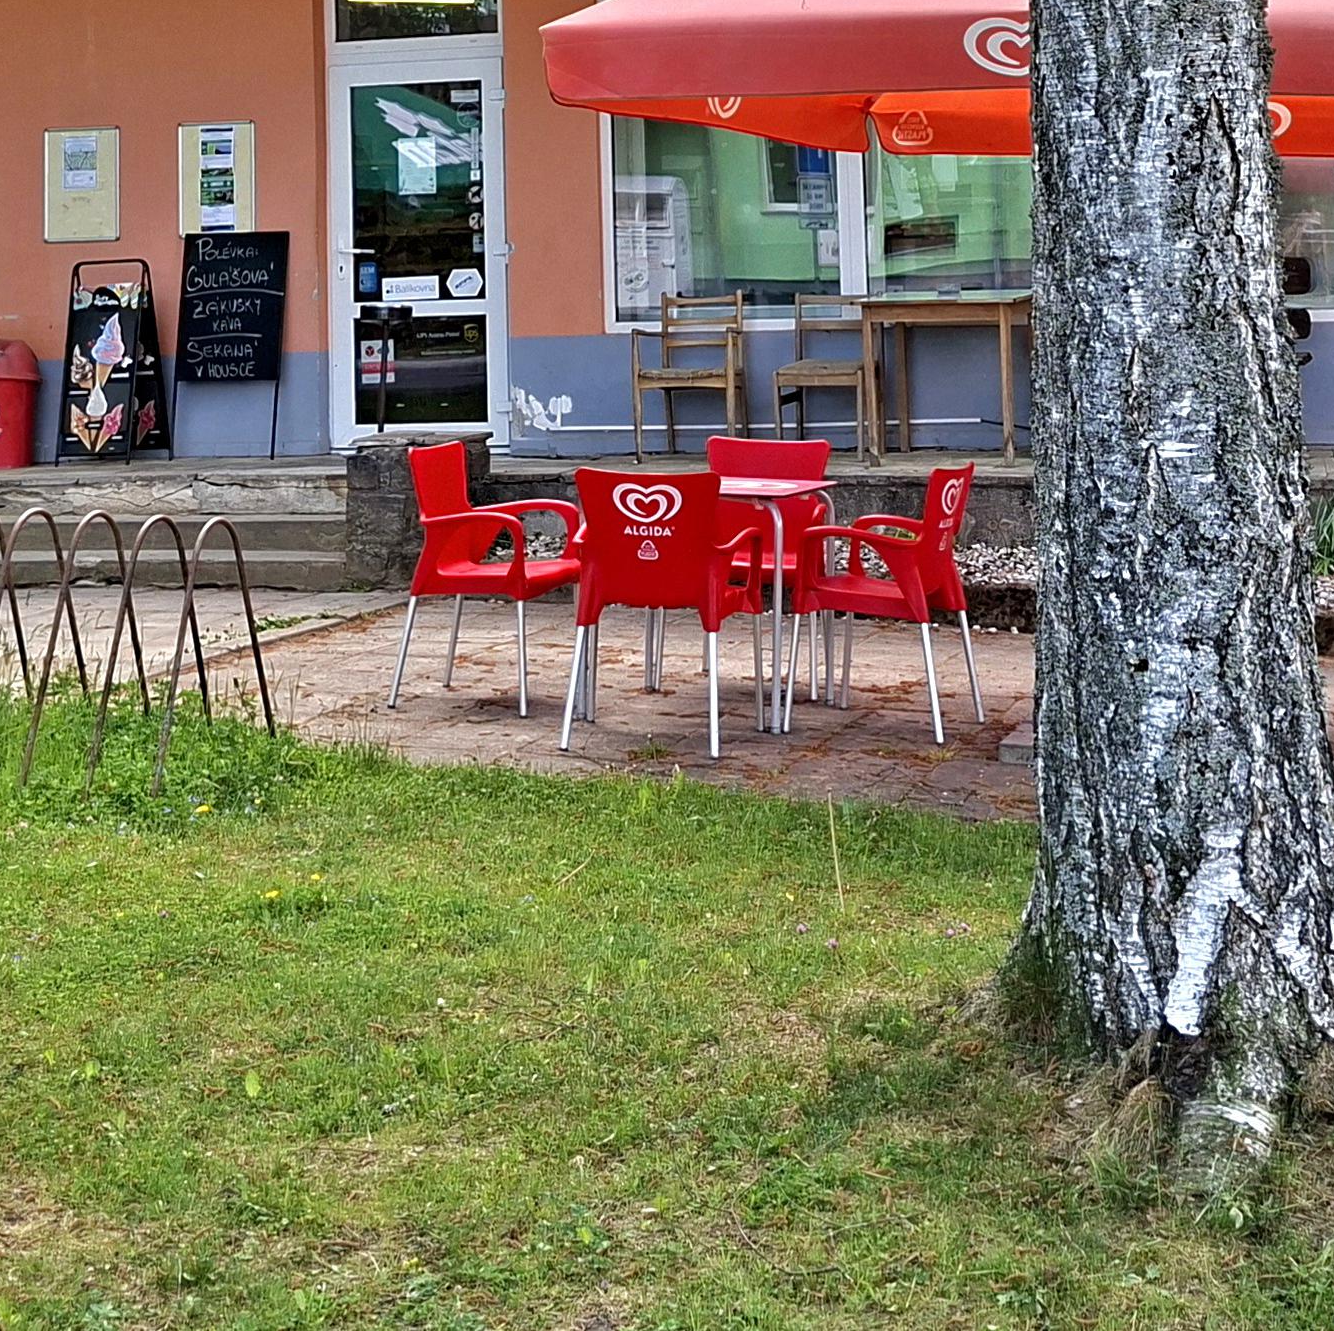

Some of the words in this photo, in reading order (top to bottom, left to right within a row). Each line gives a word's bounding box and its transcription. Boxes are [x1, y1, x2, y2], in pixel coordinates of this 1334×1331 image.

[192, 297, 261, 319] ZÁKUSKY
[208, 361, 256, 378] HOUSCE
[624, 525, 672, 537] ALGIDA
